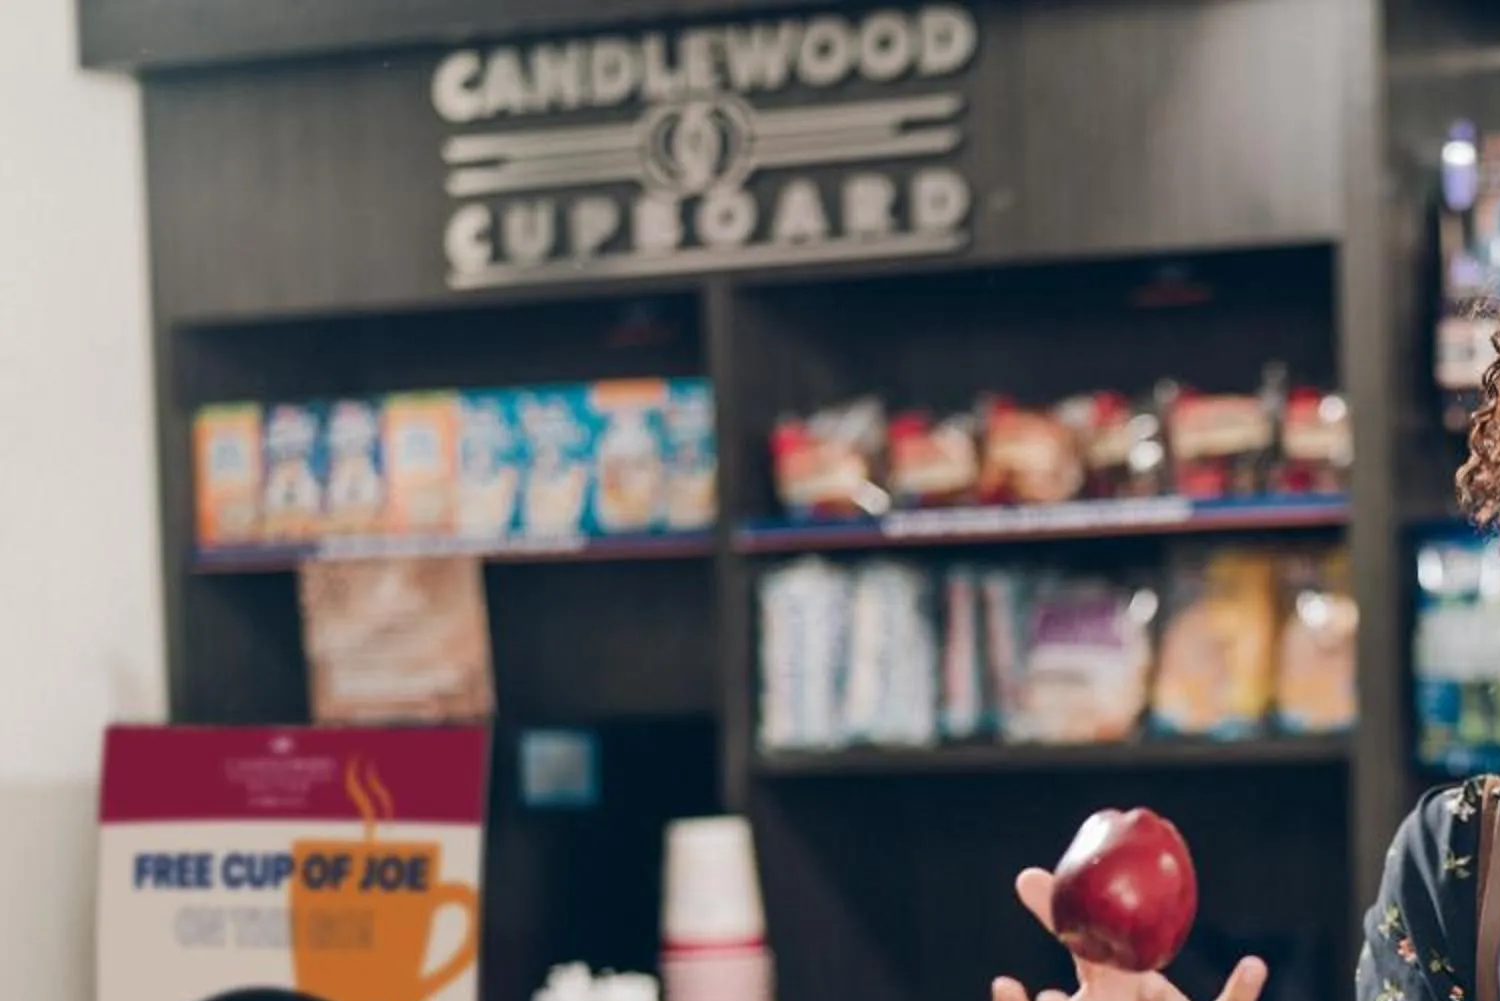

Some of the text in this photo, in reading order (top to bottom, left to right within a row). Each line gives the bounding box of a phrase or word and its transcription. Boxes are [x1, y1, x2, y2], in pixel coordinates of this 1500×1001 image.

[433, 4, 977, 122] CANDLEWOOD
[444, 165, 971, 274] CUPBOARD
[132, 852, 430, 892] FREE CUP OF JOE
